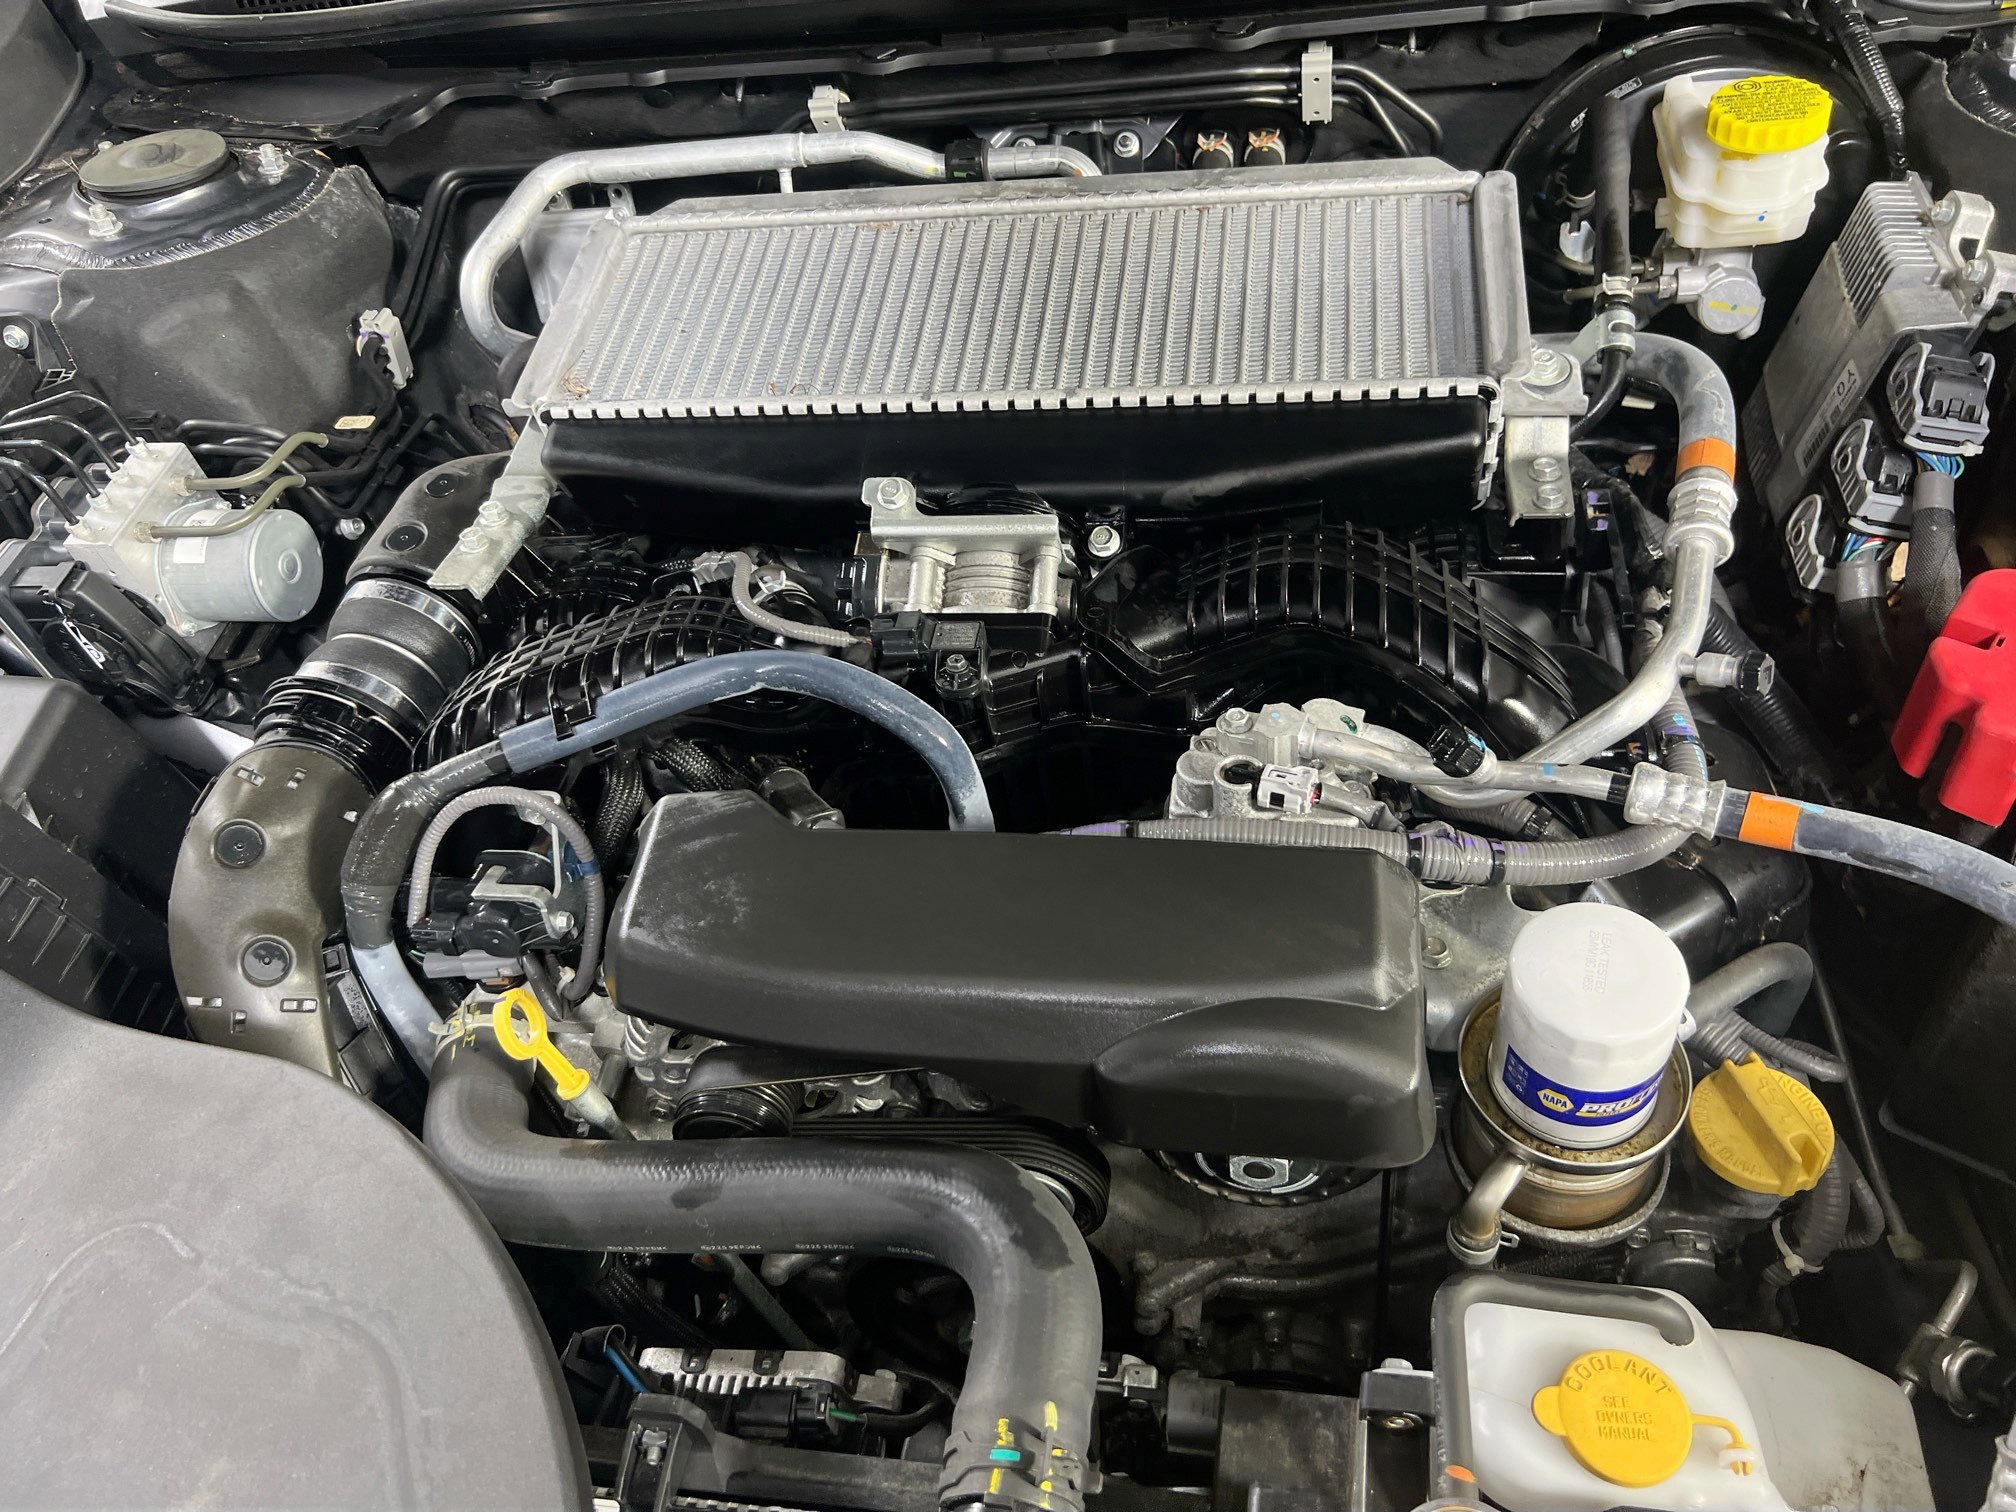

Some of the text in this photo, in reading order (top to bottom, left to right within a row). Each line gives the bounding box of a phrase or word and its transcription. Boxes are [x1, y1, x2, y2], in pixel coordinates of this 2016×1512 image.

[1543, 1093, 1567, 1108] NAPA
[1565, 1354, 1672, 1393] COOLANT
[1602, 1396, 1630, 1408] SEE
[1596, 1410, 1653, 1426] OWNERS
[1598, 1426, 1655, 1441] MANUAL
